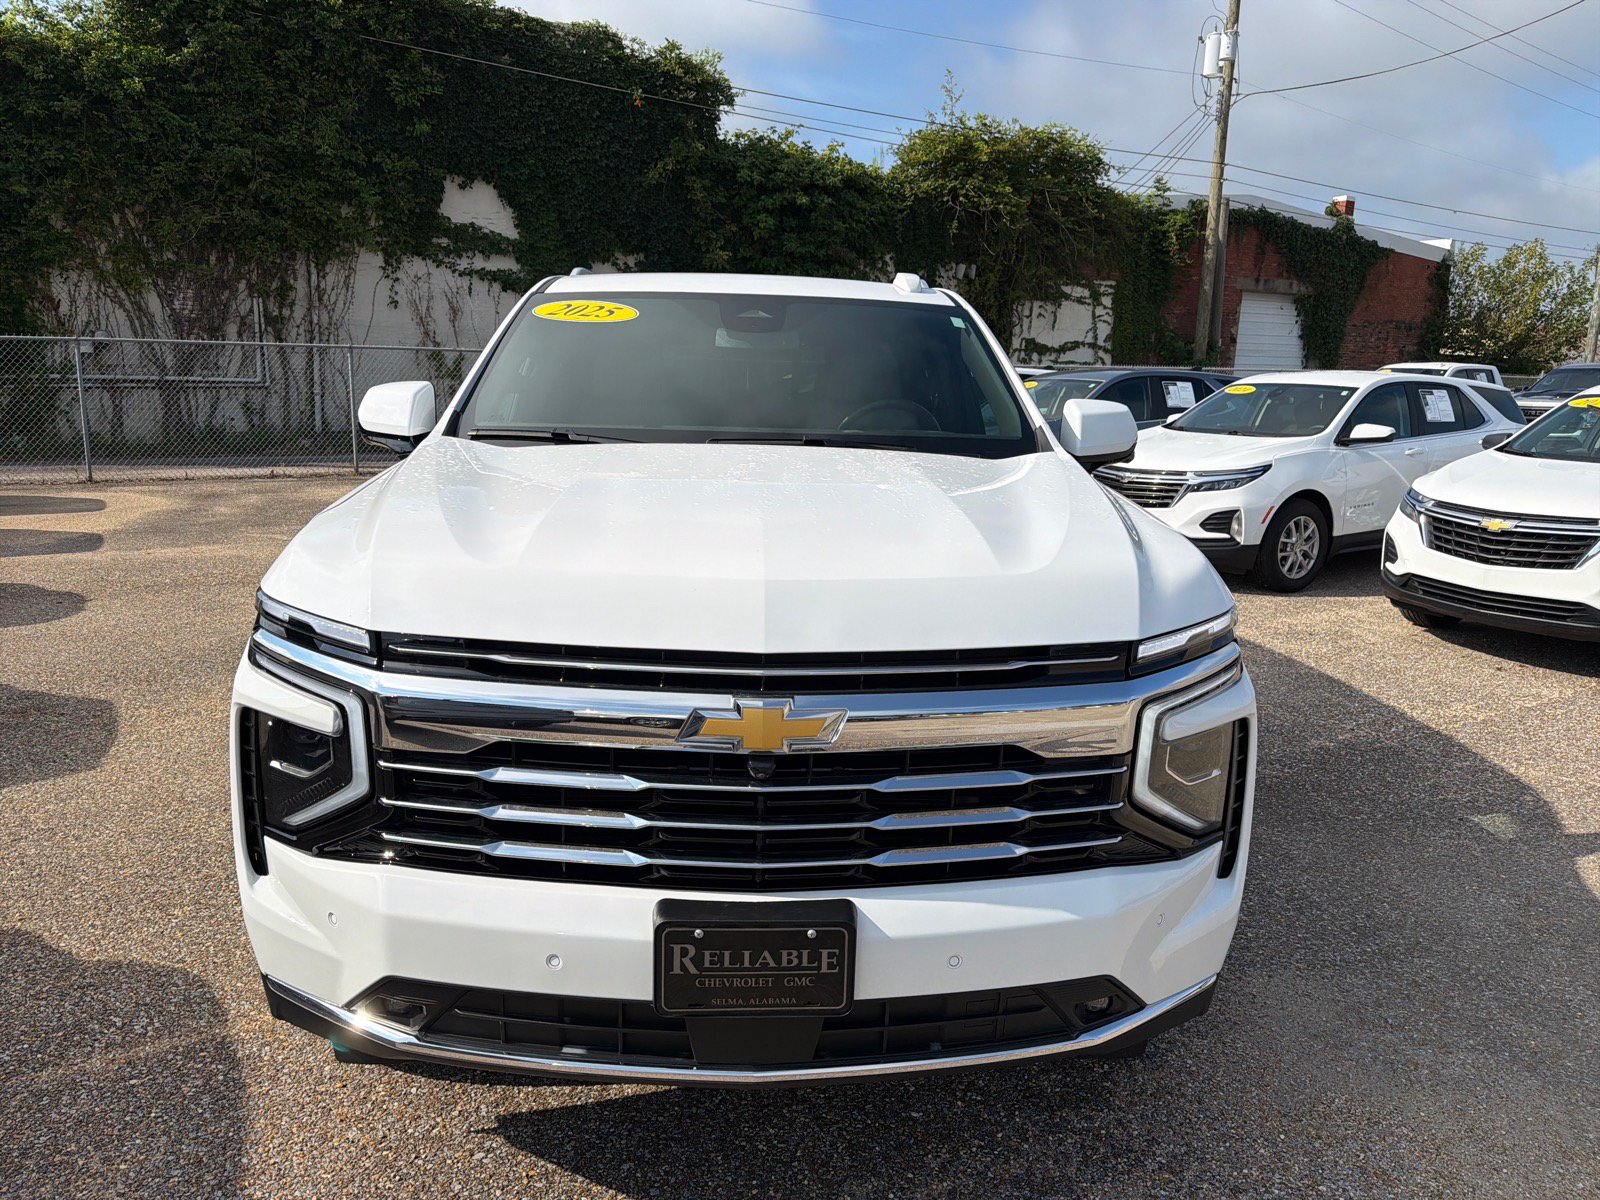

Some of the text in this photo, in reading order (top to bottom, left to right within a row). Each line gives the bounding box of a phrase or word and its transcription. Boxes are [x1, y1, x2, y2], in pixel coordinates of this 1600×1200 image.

[546, 303, 624, 318] 2025
[669, 943, 839, 975] RELIABLE
[695, 976, 816, 988] CHEVROLET GMC
[711, 997, 797, 1006] SELMA, ALABAMA
